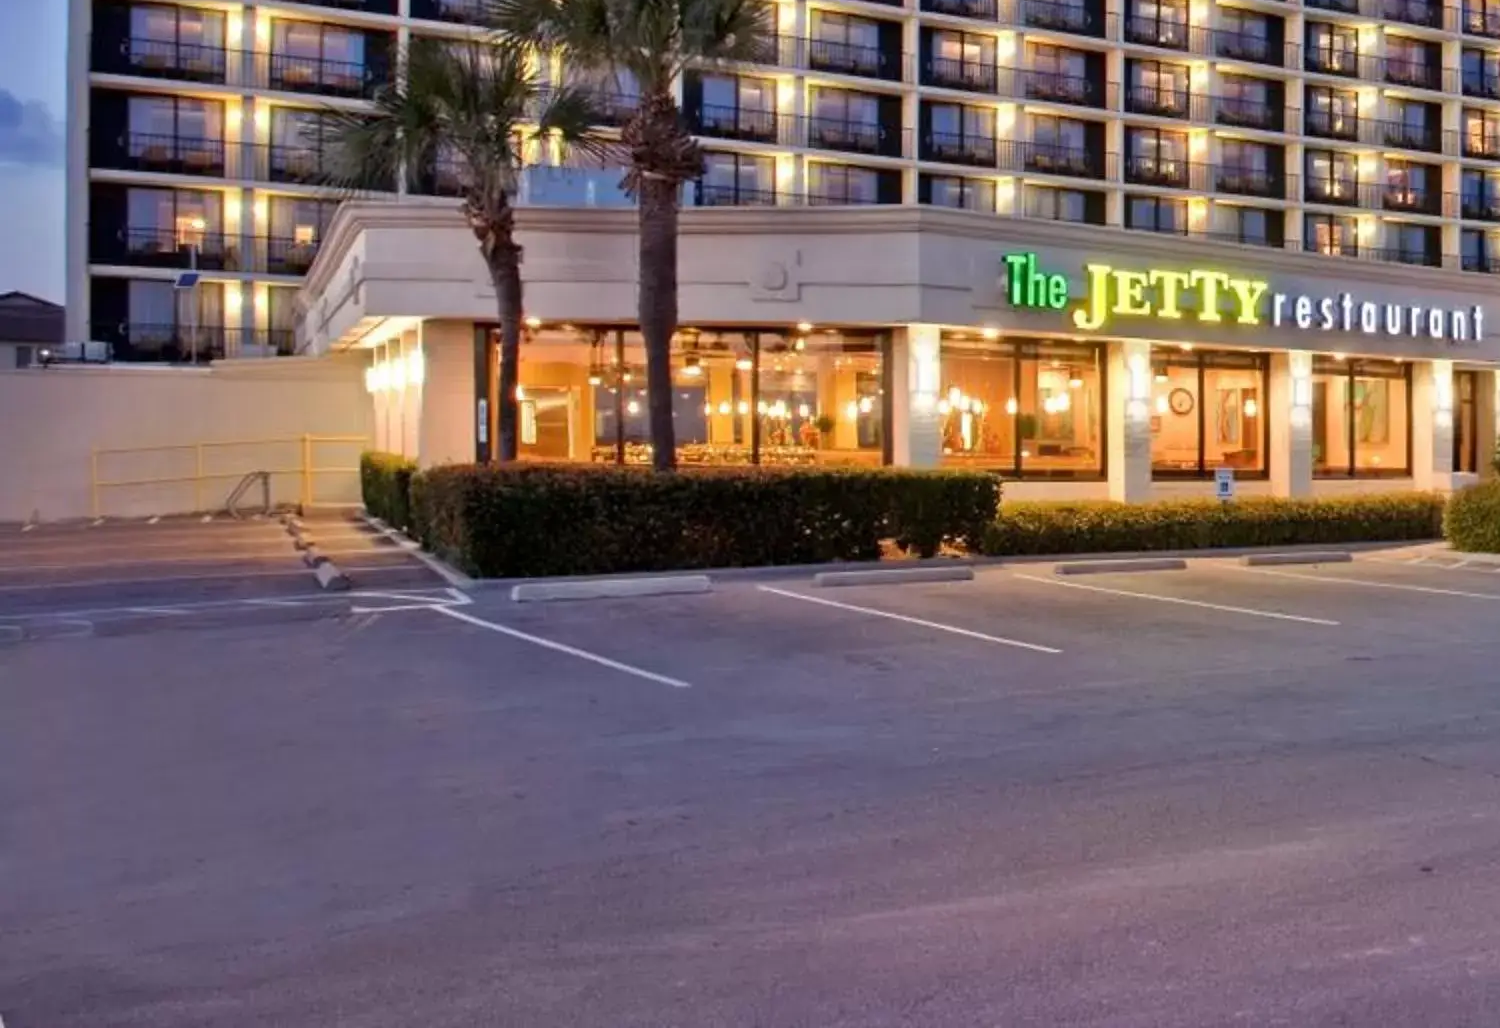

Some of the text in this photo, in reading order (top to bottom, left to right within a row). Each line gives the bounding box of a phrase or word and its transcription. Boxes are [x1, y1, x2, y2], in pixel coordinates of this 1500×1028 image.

[1004, 252, 1484, 342] The JETTY restaurant
